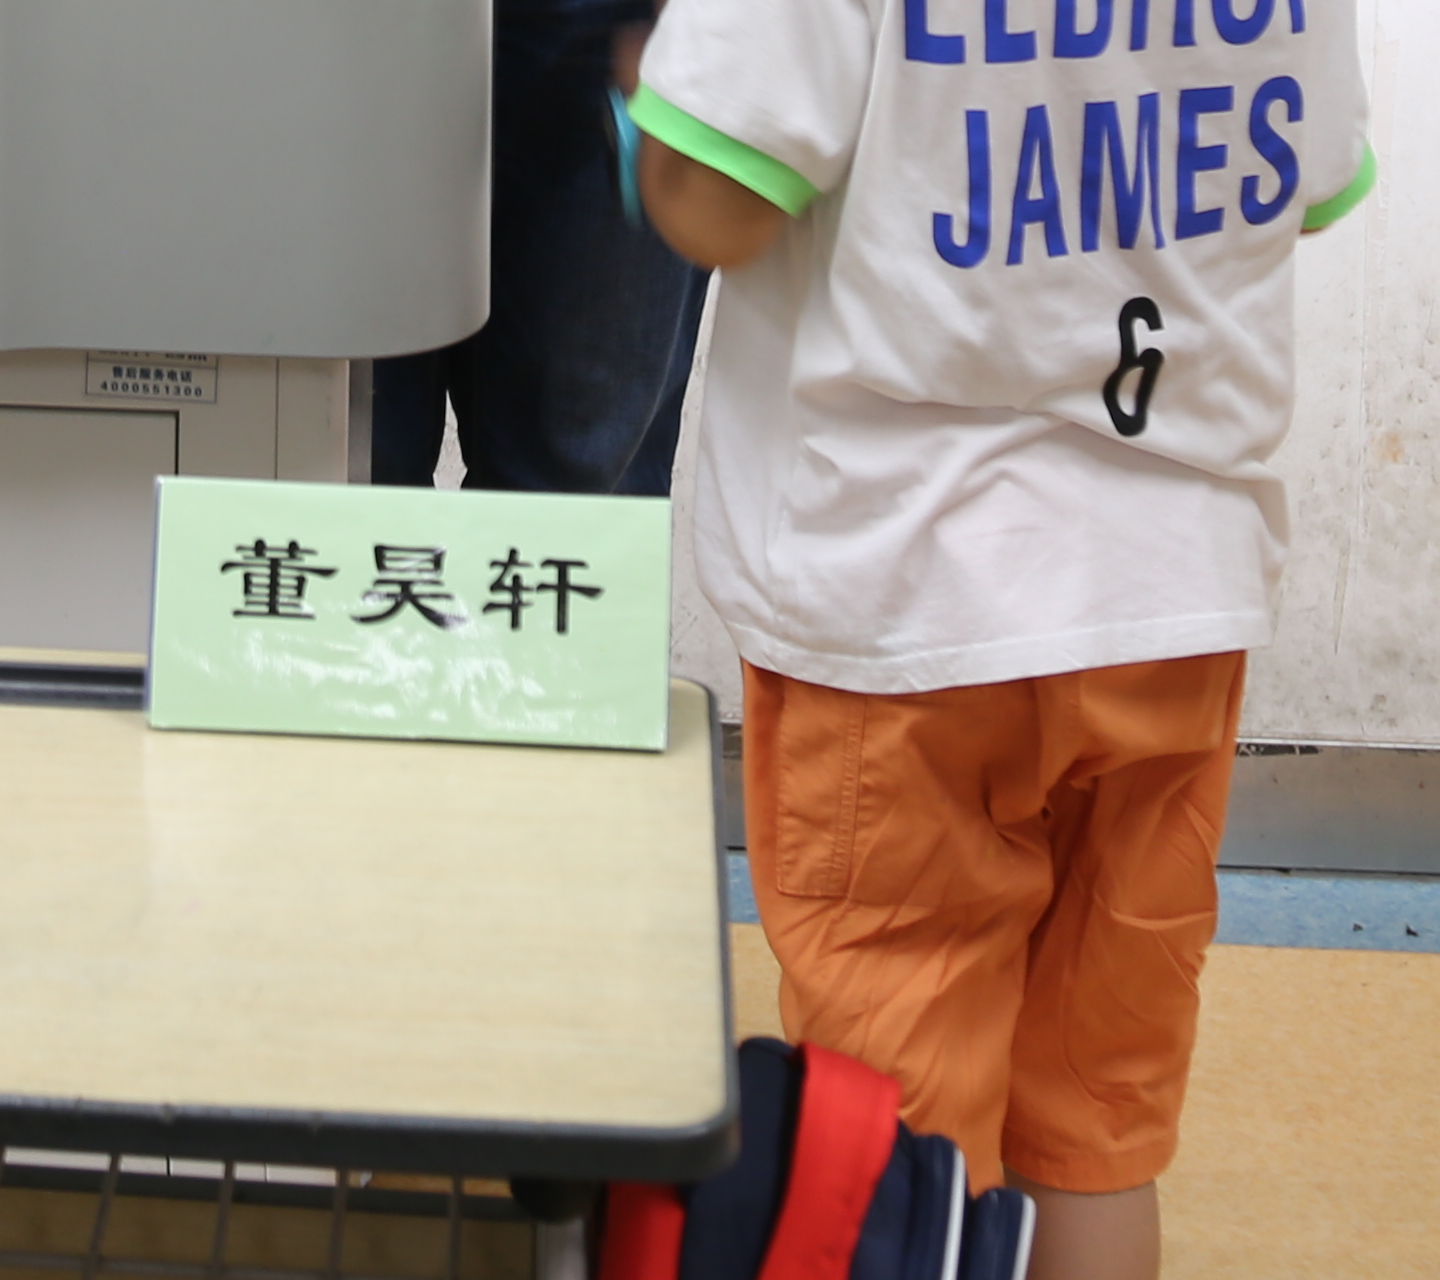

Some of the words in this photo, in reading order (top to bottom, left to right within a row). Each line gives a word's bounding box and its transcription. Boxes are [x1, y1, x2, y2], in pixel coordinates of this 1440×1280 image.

[933, 74, 1305, 270] JAMES
[100, 380, 204, 398] 4000551300
[112, 365, 194, 383] 售后服务电话
[219, 537, 604, 635] 董昊轩
